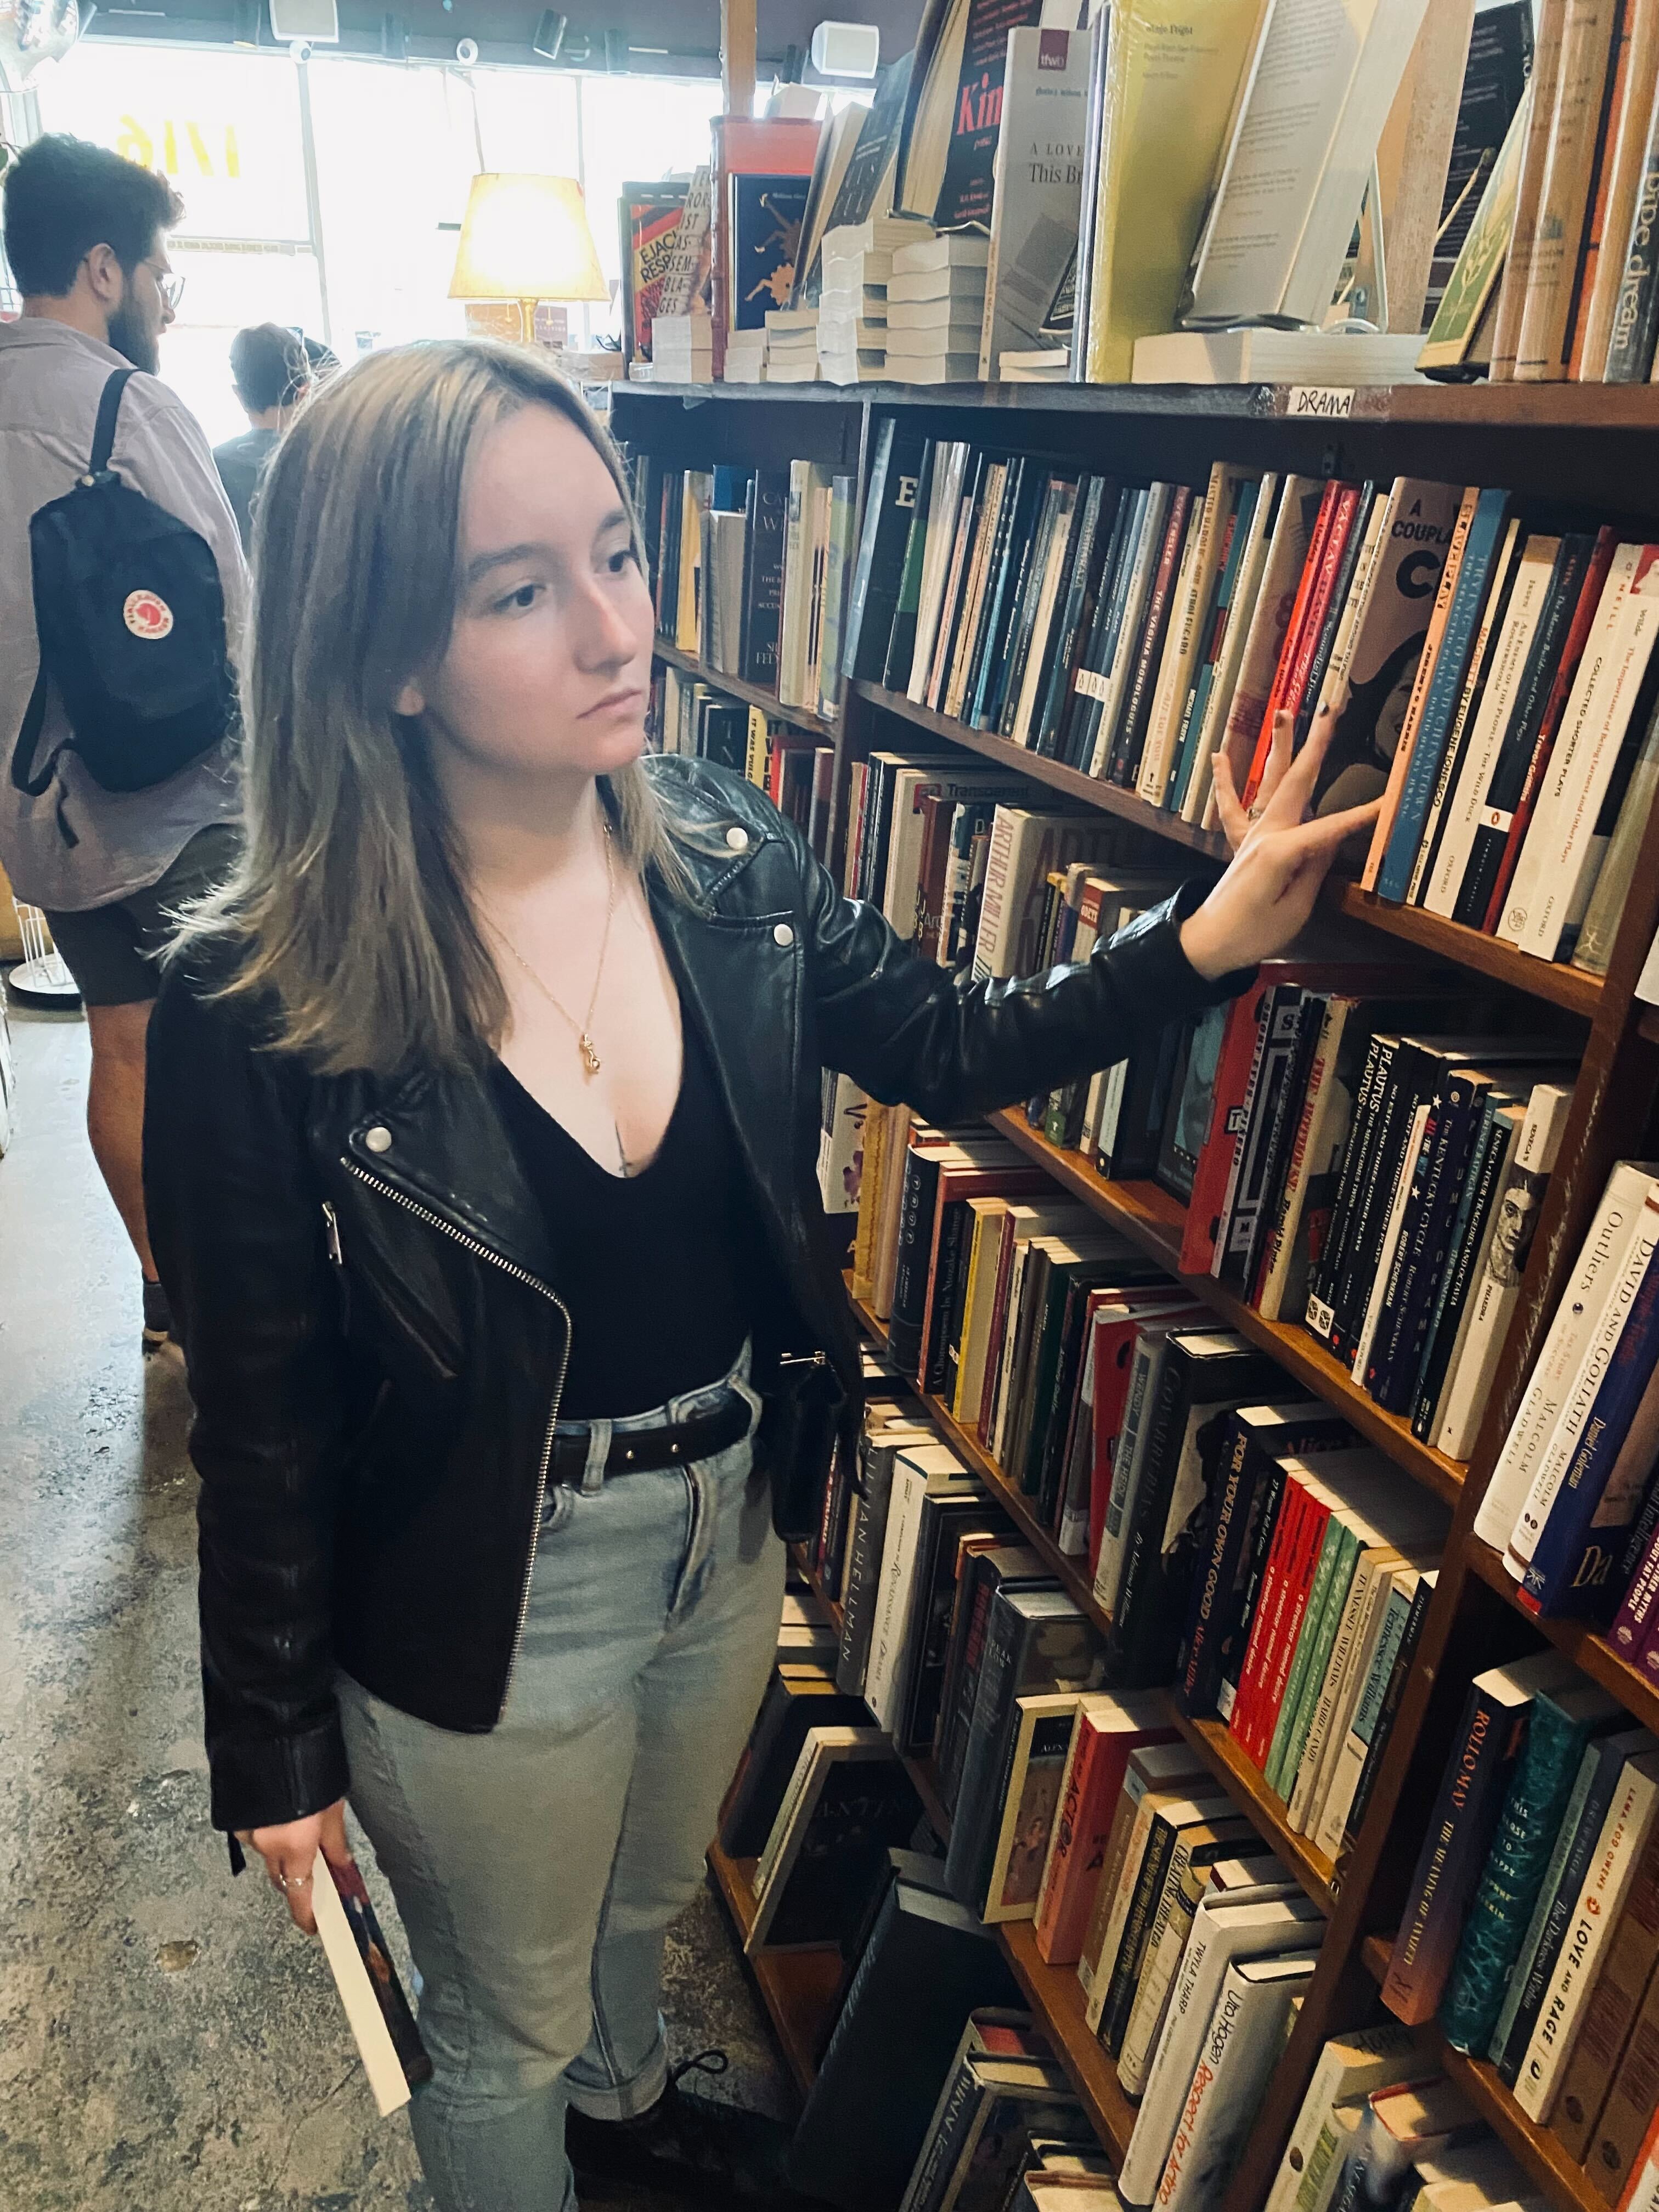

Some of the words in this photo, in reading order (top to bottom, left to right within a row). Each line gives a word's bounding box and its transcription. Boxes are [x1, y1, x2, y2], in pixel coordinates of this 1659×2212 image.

[1029, 164, 1061, 183] This
[1066, 166, 1083, 184] Br
[658, 298, 676, 314] GES
[1613, 255, 1650, 349] dream
[1296, 390, 1351, 416] DRAMA
[1409, 499, 1423, 517] A
[1153, 591, 1163, 612] THE
[1460, 553, 1489, 628] TRYING
[1521, 578, 1536, 608] IBSEN
[1605, 561, 1634, 633] O'NEILL
[1142, 614, 1157, 657] VAGINA
[1517, 622, 1528, 637] AN
[1632, 608, 1647, 637] Wilde
[1453, 633, 1469, 657] TO
[1465, 626, 1488, 685] MACBETT
[1506, 639, 1523, 674] ENEMY
[1623, 646, 1635, 664] The
[1415, 644, 1432, 695] JEREMY
[1439, 663, 1460, 710] FIND
[1503, 675, 1513, 688] OF
[1578, 656, 1603, 717] COLLECTED
[1125, 658, 1148, 734] MONOLOGUES
[1183, 689, 1197, 719] MICHAEL
[1461, 686, 1471, 703] BY
[1497, 688, 1509, 707] THE
[1605, 664, 1629, 719] Importance
[1177, 719, 1189, 743] FRAYN
[1400, 706, 1417, 753] HARRIS
[1447, 704, 1466, 753] EUGENE
[1487, 708, 1503, 743] PEOPLE
[1562, 719, 1583, 765] SHORTER
[1602, 720, 1611, 731] of
[1479, 751, 1491, 770] THE
[1530, 733, 1545, 764] Trevor
[1592, 731, 1607, 759] Being
[1409, 714, 1447, 823] CHINATOWN
[1431, 754, 1453, 808] IONESCO
[1471, 771, 1485, 796] WILD
[1519, 764, 1537, 803] Griffiths
[1553, 768, 1568, 798] PLAYS
[1582, 759, 1599, 793] Earnest
[1463, 797, 1478, 825] DUCK
[1576, 794, 1588, 812] and
[1567, 812, 1582, 840] Other
[986, 815, 1014, 891] ARTHUR
[1559, 839, 1573, 865] Plays
[1439, 854, 1455, 894] OXFORD
[977, 888, 1003, 953] MILLER
[1352, 1041, 1384, 1106] PLAUTUS
[1366, 1046, 1395, 1113] PLAUTUS
[1390, 1084, 1398, 1099] NO
[1383, 1102, 1394, 1126] EXIT
[1410, 1093, 1419, 1109] NO
[1378, 1127, 1388, 1148] AND
[1404, 1110, 1415, 1135] EXIT
[1424, 1118, 1438, 1137] ALL
[1475, 1108, 1494, 1151] TERENCE
[1398, 1136, 1409, 1159] AND
[1421, 1138, 1432, 1153] THE
[1487, 1128, 1503, 1165] SENECA
[1370, 1149, 1383, 1183] THREE
[1389, 1160, 1403, 1195] THREE
[1415, 1154, 1429, 1176] WAY
[1422, 1136, 1450, 1209] KENTUCKY
[1463, 1152, 1483, 1200] RATTIGAN
[1479, 1170, 1492, 1197] FOUR
[1274, 1198, 1292, 1238] Harold
[1361, 1185, 1374, 1218] OTHER
[1381, 1195, 1395, 1231] OTHER
[1353, 1221, 1366, 1252] PLAYS
[1411, 1210, 1432, 1257] CYCLE
[1465, 1198, 1485, 1246] TRAGEDIES
[1266, 1238, 1283, 1275] Pinter
[1373, 1232, 1386, 1263] PLAYS
[1395, 1229, 1408, 1261] ROBERT
[1459, 1245, 1472, 1268] AND
[1578, 1209, 1627, 1295] Outliers
[1384, 1261, 1401, 1308] SCHENKKAN
[1401, 1265, 1418, 1303] ROBERT
[1449, 1266, 1466, 1307] OCTAVIA
[1616, 1235, 1657, 1306] DAVID
[1477, 1283, 1493, 1322] PHAEDRA
[1386, 1304, 1408, 1363] SCHENKKAN
[1602, 1307, 1625, 1344] AND
[1130, 1372, 1146, 1417] WENDY
[1564, 1344, 1612, 1437] GOLIATH
[1504, 1385, 1545, 1468] GLADWELL
[1517, 1397, 1559, 1476] MALCOLM
[1583, 1415, 1607, 1452] Daniel
[1121, 1443, 1133, 1464] THE
[1230, 1431, 1248, 1472] FOR
[1569, 1447, 1596, 1491] Goleman
[1114, 1465, 1130, 1499] HEIDI
[1271, 1479, 1279, 1489] 27
[1531, 1442, 1559, 1502] GLADWELL
[1538, 1448, 1567, 1508] MALCOLM
[1218, 1472, 1240, 1523] YOUR
[1265, 1489, 1277, 1514] Wagons
[1261, 1527, 1269, 1536] of
[1262, 1514, 1272, 1528] Full
[1209, 1522, 1229, 1570] OWN
[1256, 1536, 1267, 1557] Cotton
[841, 1549, 864, 1662] HELLMAN
[1198, 1567, 1220, 1621] GOOD
[1297, 1593, 1305, 1601] a
[1345, 1572, 1368, 1632] TENNESSEE
[1286, 1602, 1302, 1643] streetcar
[1372, 1606, 1401, 1672] Tennessee
[1278, 1642, 1293, 1675] named
[1328, 1635, 1350, 1689] WILLIAMS
[1270, 1674, 1284, 1704] desire
[1356, 1671, 1382, 1724] Williams
[1315, 1696, 1333, 1726] HARD
[1305, 1728, 1324, 1764] CANDY
[1460, 1708, 1491, 1772] ROLLO
[1449, 1768, 1474, 1812] MAY
[1620, 1786, 1637, 1820] LAMA
[1439, 1819, 1455, 1845] THE
[1610, 1821, 1626, 1849] ROD
[1162, 1843, 1191, 1900] CREATING
[1423, 1846, 1447, 1899] MEANING
[1595, 1850, 1616, 1892] OWENS
[1148, 1898, 1175, 1949] THEATER
[1418, 1899, 1431, 1918] OF
[1550, 1899, 1569, 1923] The
[1188, 1939, 1207, 1977] TWYLA
[1402, 1921, 1424, 1966] ANXIETY
[1534, 1920, 1561, 1971] Darkness
[1565, 1918, 1594, 1969] LOVE
[1176, 1978, 1195, 2015] THARP
[1521, 1971, 1544, 2011] Within
[1559, 1968, 1575, 1994] AND
[1221, 1989, 1244, 2019] Uta
[1539, 1994, 1567, 2046] RAGE
[1206, 2013, 1237, 2068] Hagen
[1178, 2058, 1217, 2133] Respect
[1172, 2130, 1193, 2157] for
[1156, 2154, 1184, 2207] Acting
